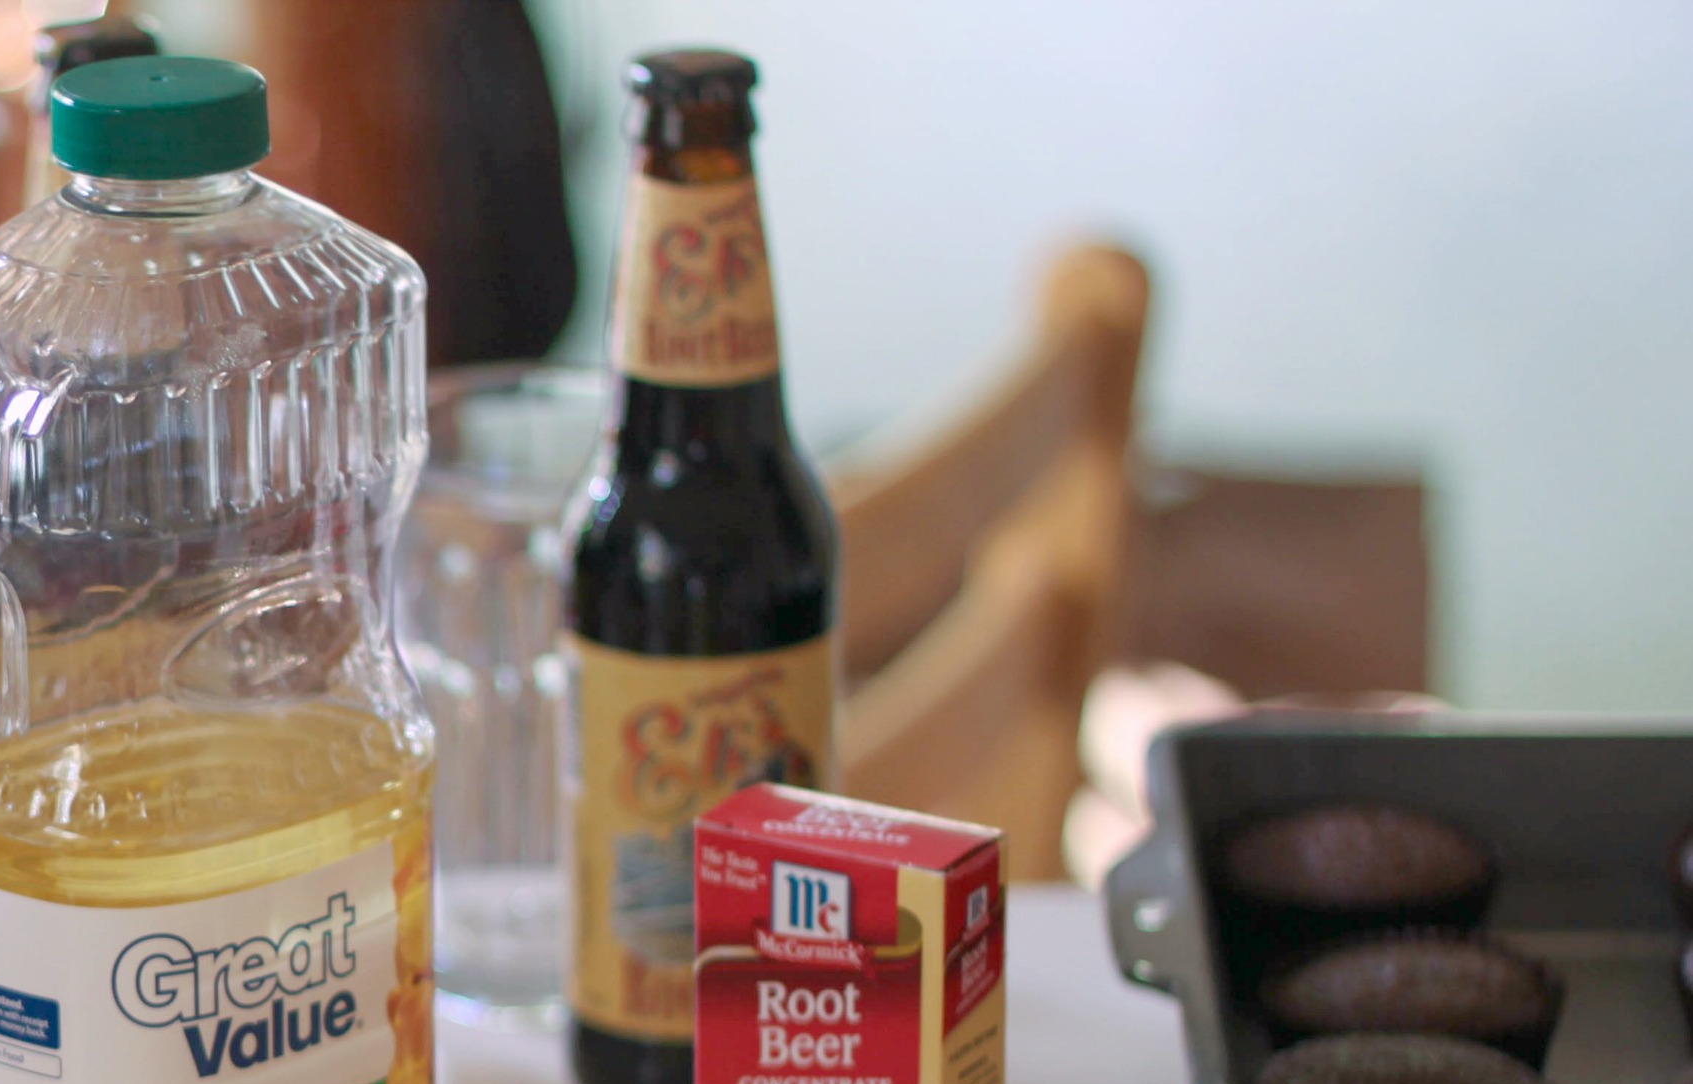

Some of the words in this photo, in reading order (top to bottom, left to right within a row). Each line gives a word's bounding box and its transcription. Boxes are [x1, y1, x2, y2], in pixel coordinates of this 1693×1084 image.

[111, 891, 356, 1028] Great
[756, 929, 860, 969] McCormick
[757, 980, 861, 1024] Root
[183, 990, 356, 1078] Value
[758, 1025, 861, 1069] Beer
